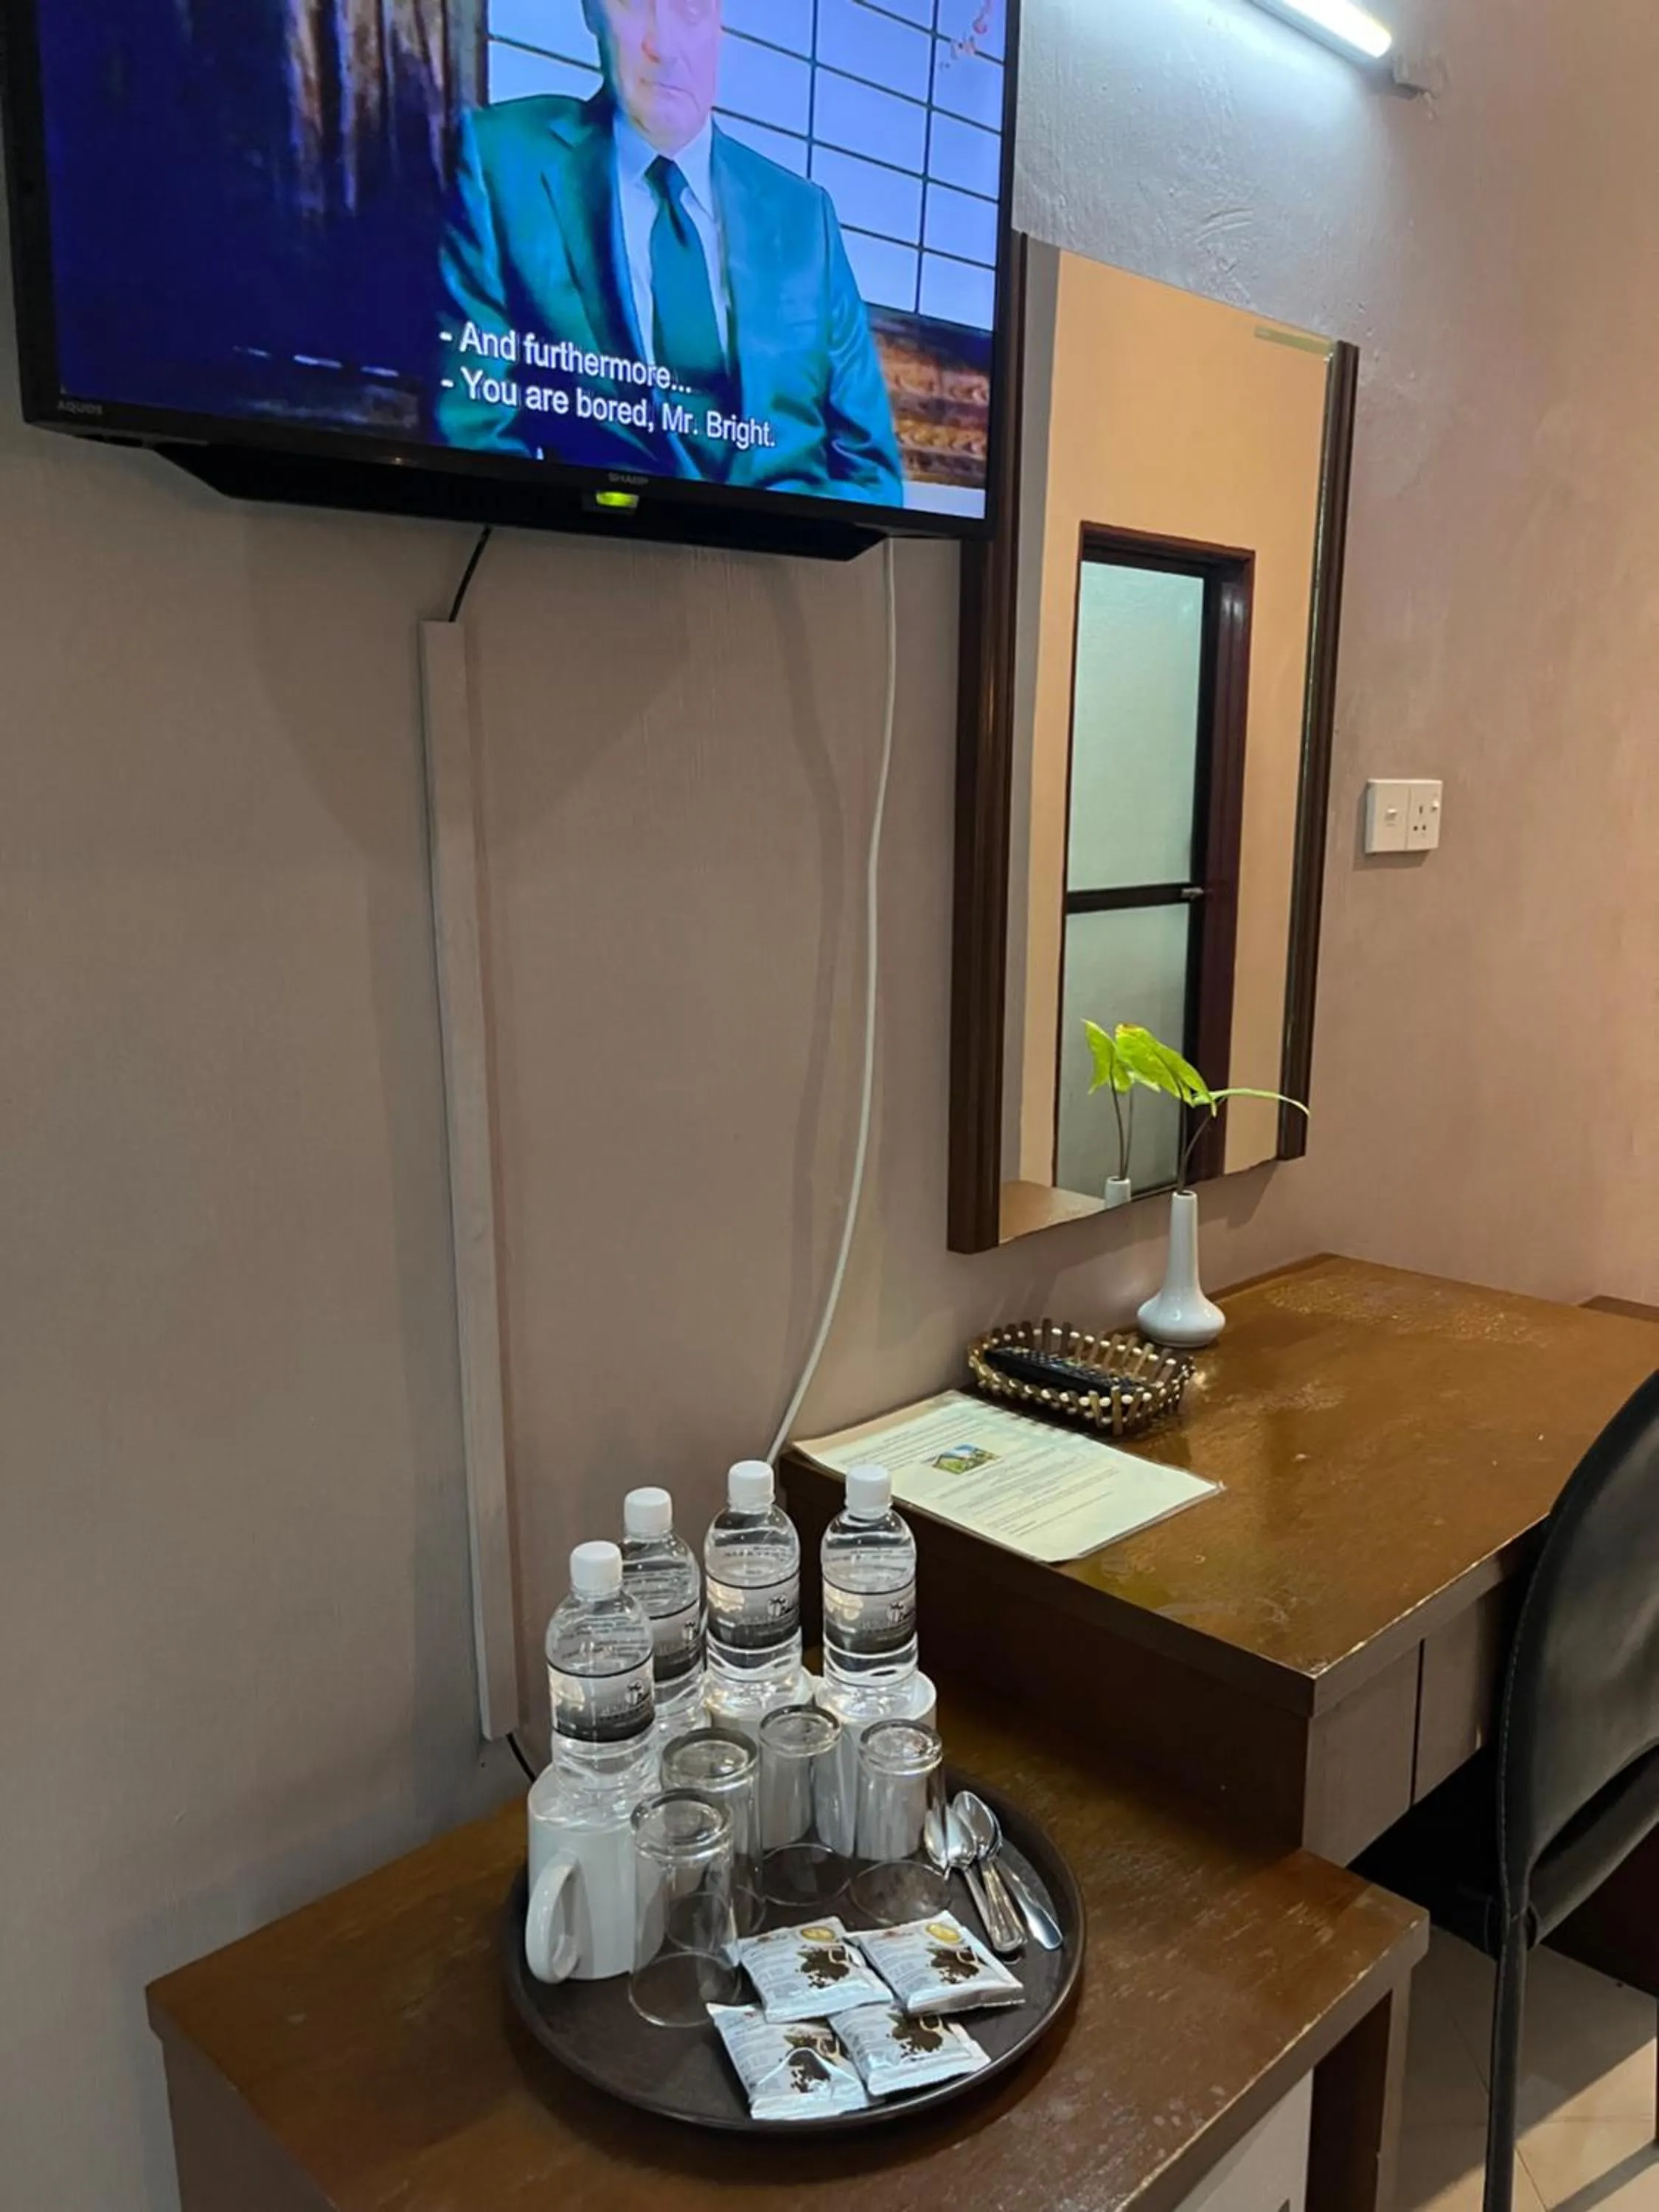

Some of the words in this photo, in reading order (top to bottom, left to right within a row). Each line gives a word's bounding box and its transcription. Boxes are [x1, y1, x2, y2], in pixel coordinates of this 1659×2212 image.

[459, 321, 516, 361] And
[523, 333, 692, 393] furthermore...
[460, 366, 517, 406] You
[526, 387, 568, 414] are
[576, 389, 655, 432] bored,
[662, 403, 699, 435] Mr.
[706, 411, 776, 449] Bright.
